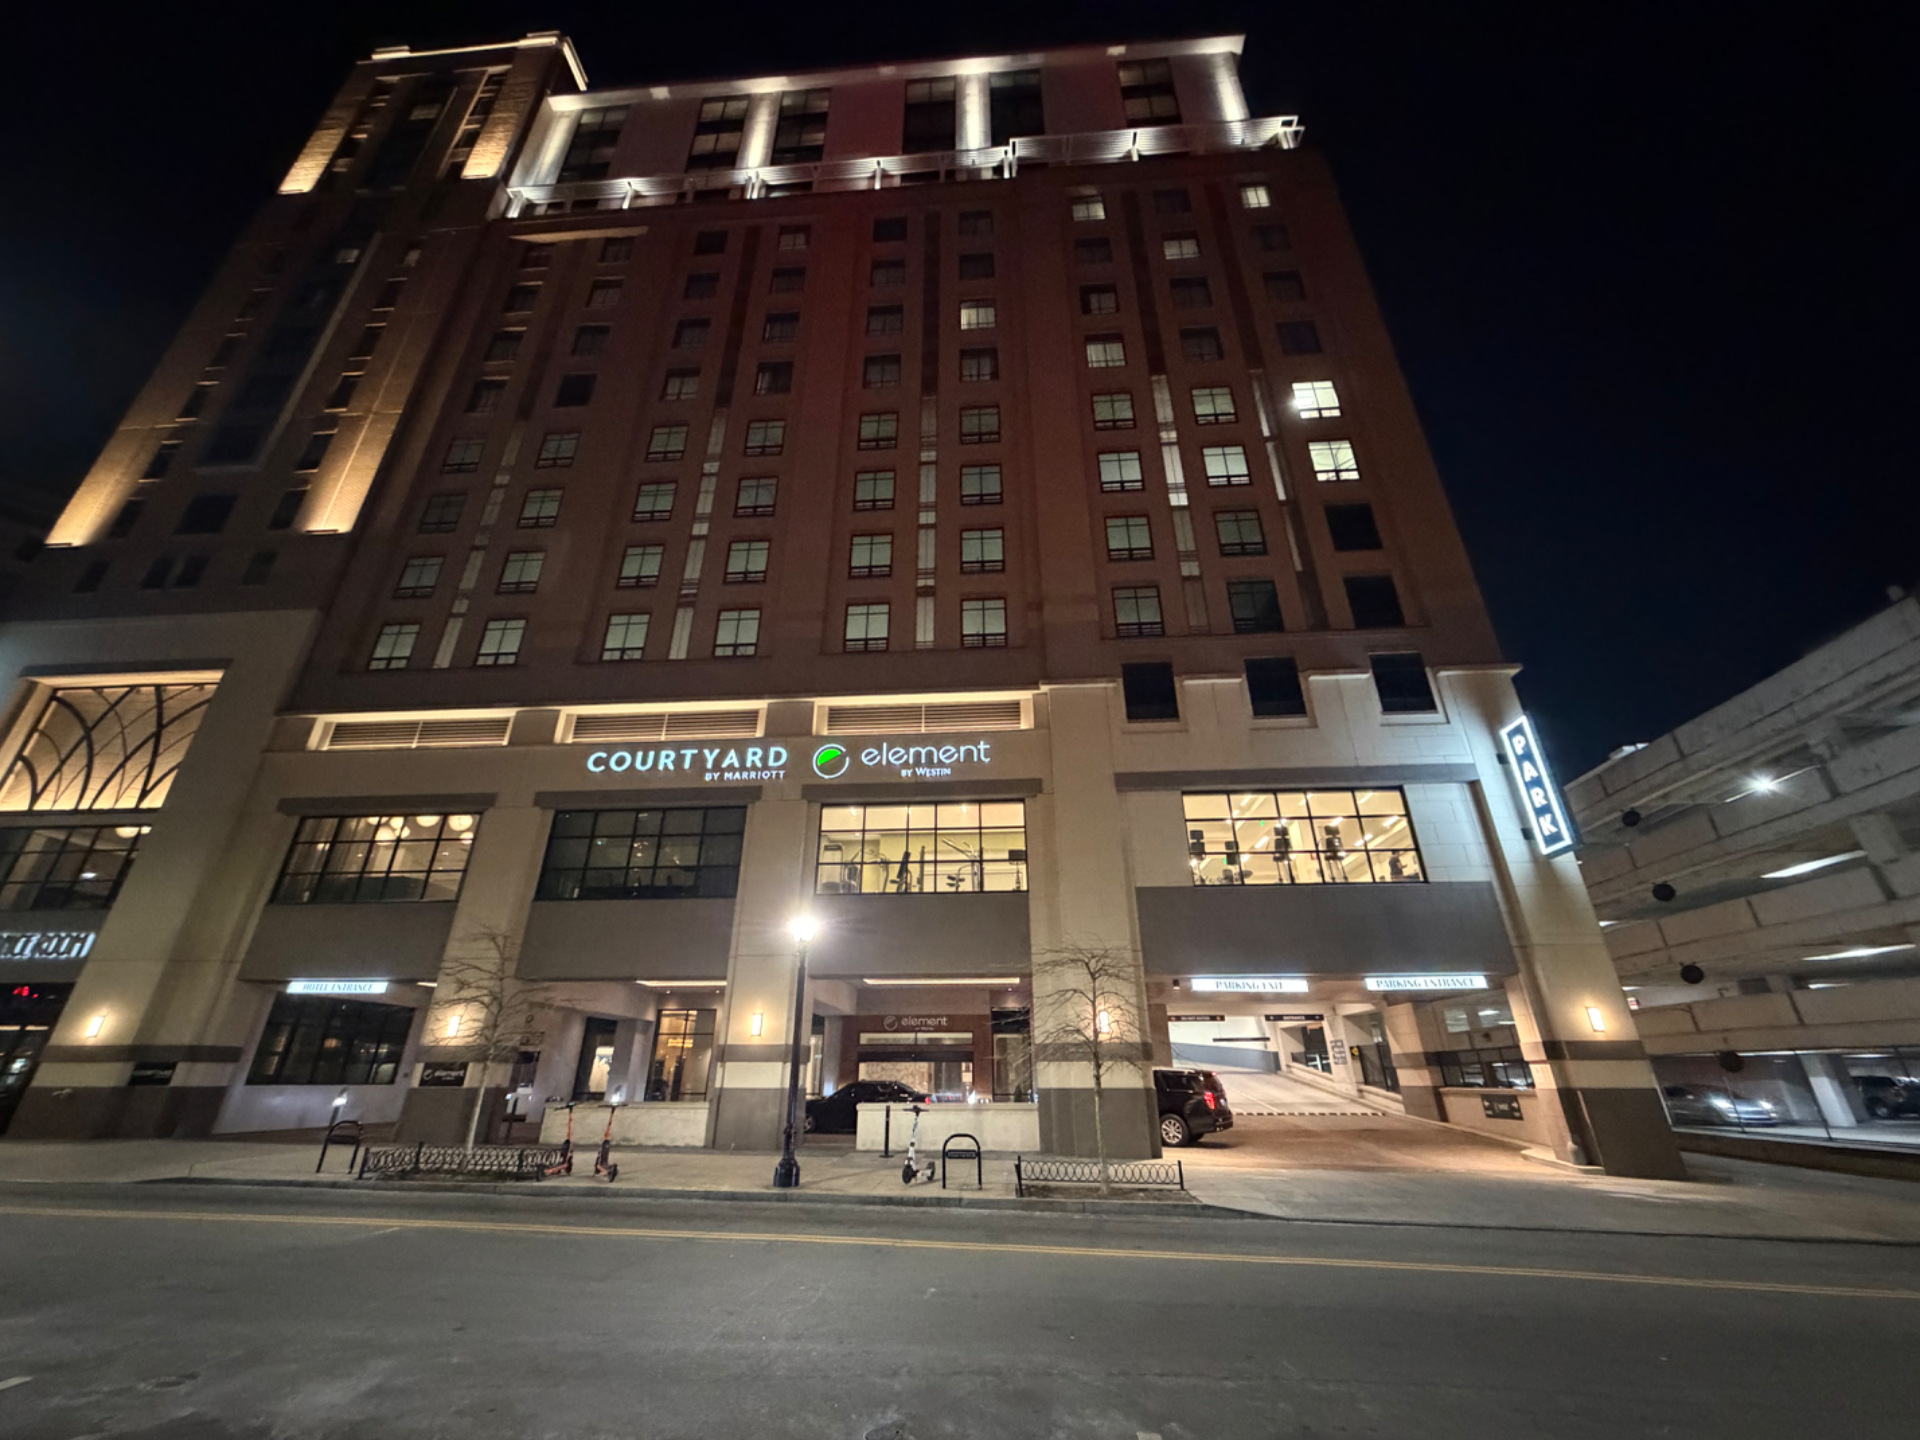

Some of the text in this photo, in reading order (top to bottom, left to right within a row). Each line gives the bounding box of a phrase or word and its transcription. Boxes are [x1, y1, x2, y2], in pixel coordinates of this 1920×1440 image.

[861, 740, 991, 766] element
[587, 746, 788, 773] COURTYARD
[704, 770, 785, 782] BY MARRIOTT
[900, 767, 951, 778] BY WESTIN
[1512, 735, 1558, 837] PARK
[302, 983, 374, 992] HOTEL ENTRANCE
[1215, 980, 1283, 990] PARKING EXIT
[1376, 977, 1475, 989] PARKING ENTRANCE
[901, 1015, 948, 1027] element
